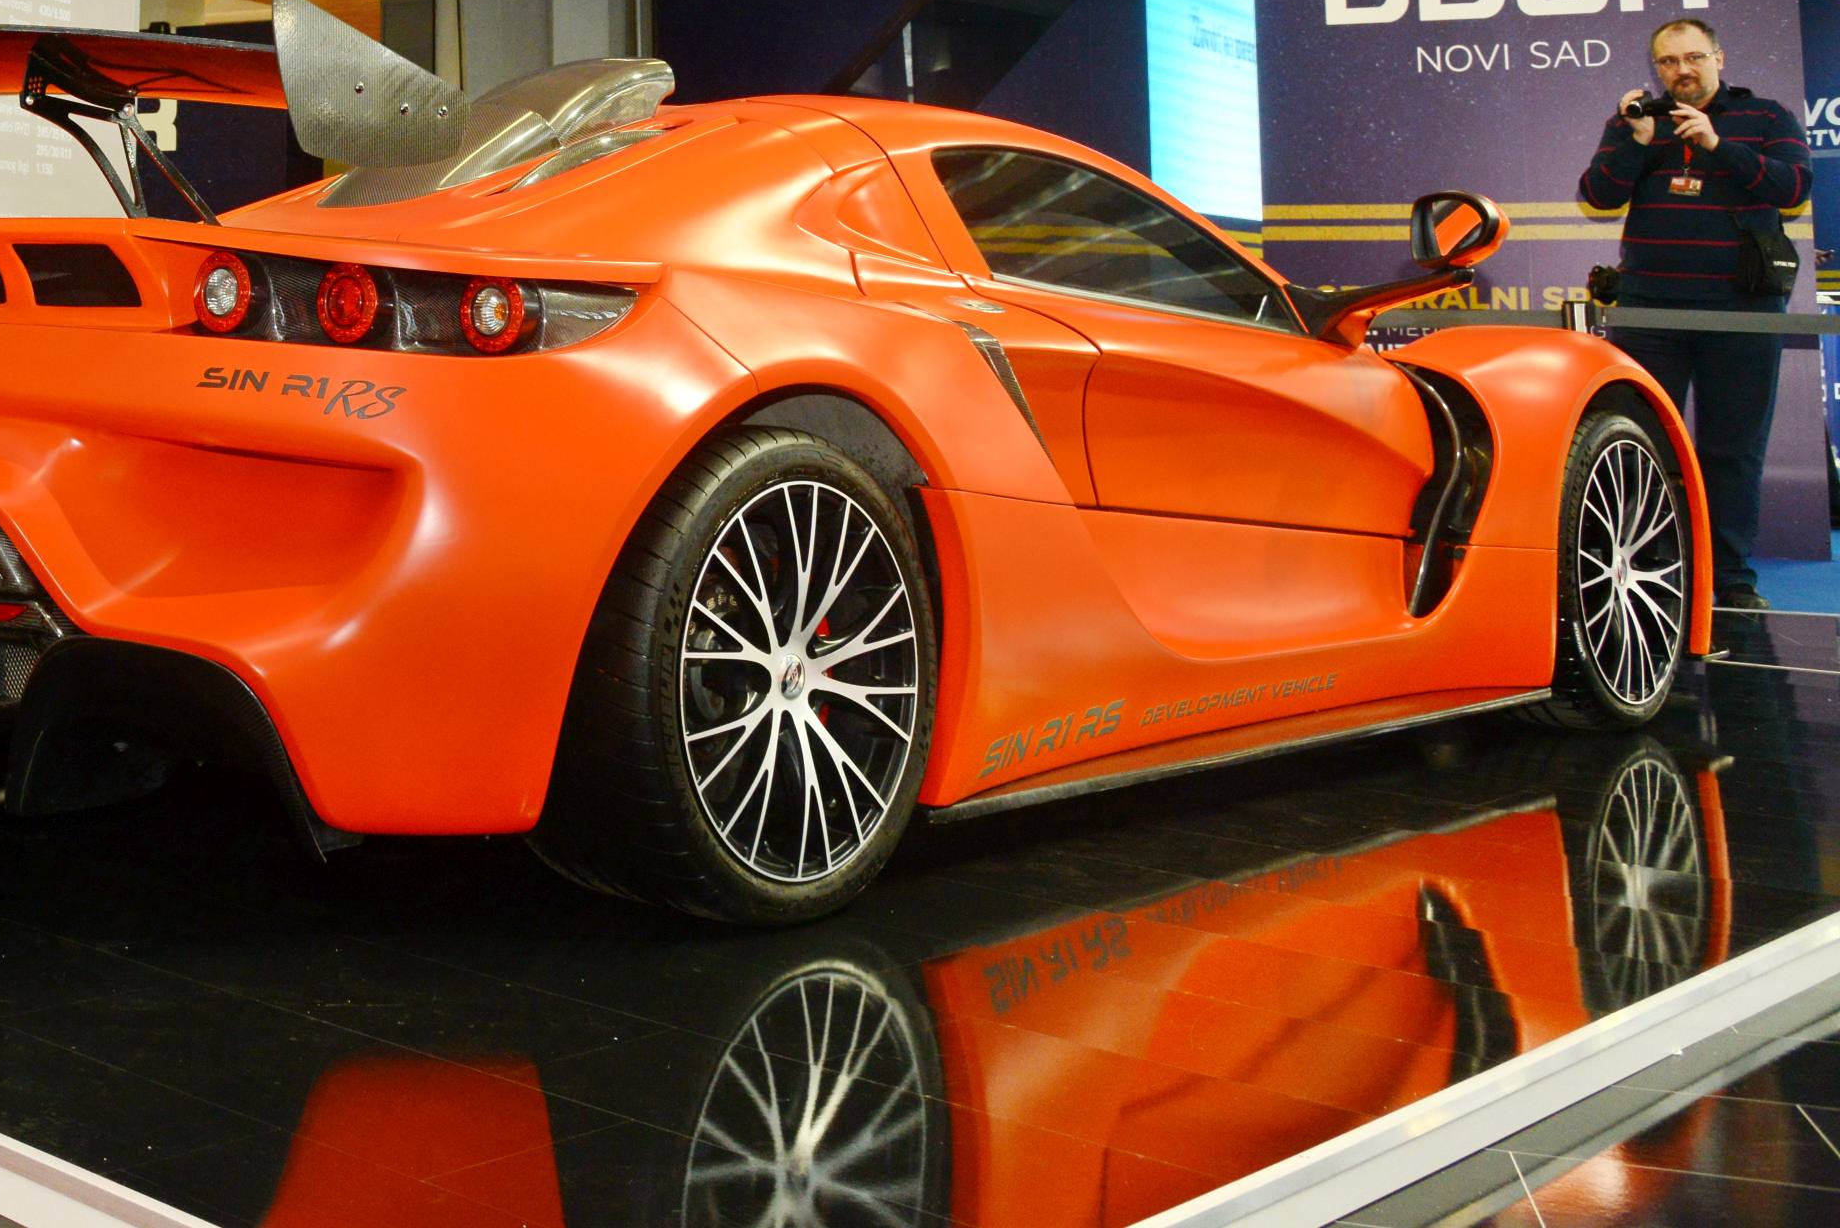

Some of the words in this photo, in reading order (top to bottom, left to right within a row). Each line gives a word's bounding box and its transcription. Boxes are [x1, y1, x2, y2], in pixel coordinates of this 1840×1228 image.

[1416, 41, 1510, 73] NOVI
[1529, 39, 1611, 70] SAD
[196, 367, 270, 392] SIN
[281, 374, 330, 399] R1
[323, 379, 408, 420] RS
[977, 725, 1034, 778] SIN
[1034, 714, 1073, 757] R1
[1075, 699, 1125, 743] RS
[1140, 684, 1266, 727] DEVELOPMENT
[1271, 673, 1338, 699] VEHICLE
